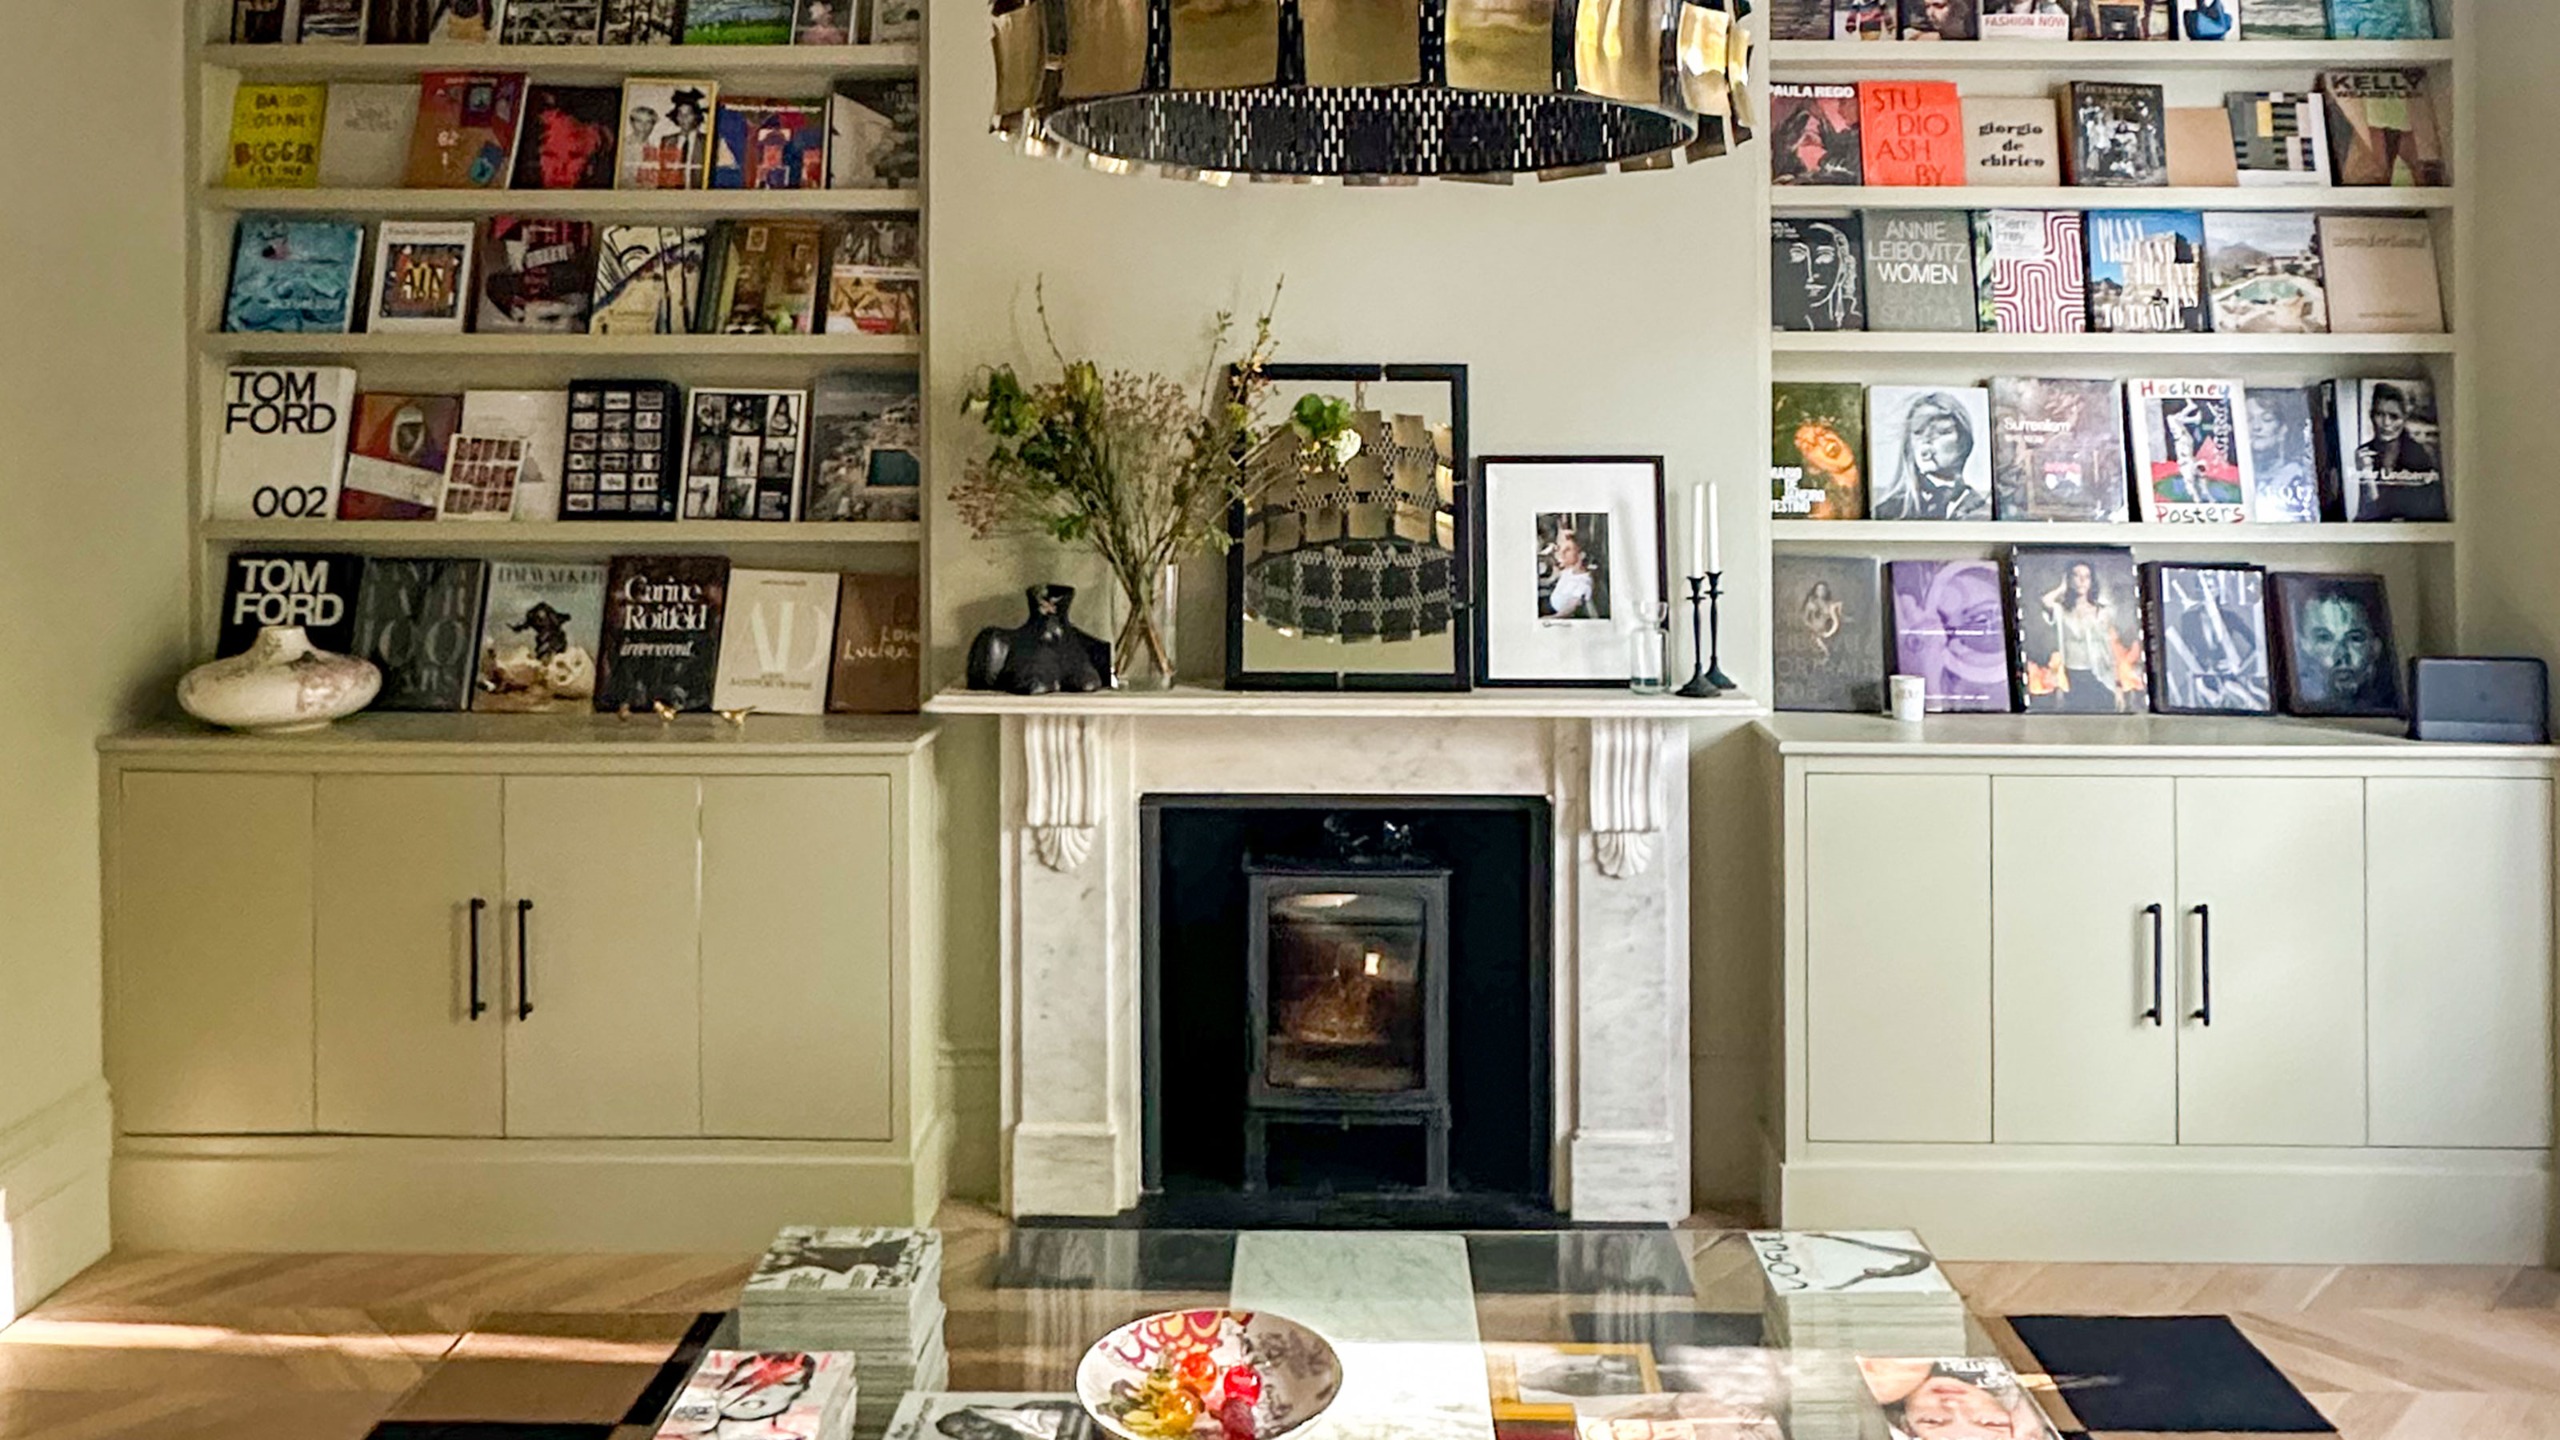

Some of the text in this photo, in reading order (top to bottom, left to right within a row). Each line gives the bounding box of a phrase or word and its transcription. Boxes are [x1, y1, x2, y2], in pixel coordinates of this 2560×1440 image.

[1984, 15, 2066, 28] FASHION NOW
[1814, 85, 1855, 99] REGO
[2331, 73, 2422, 91] KELLY
[1872, 88, 1922, 112] STU
[1897, 113, 1950, 137] DIO
[1979, 121, 2044, 137] giorgio
[1875, 138, 1932, 162] ASH
[2002, 138, 2024, 152] de
[1915, 163, 1946, 186] BY
[1885, 219, 1947, 241] ANNIE
[1867, 240, 1969, 262] LEIBOVITZ
[1877, 263, 1959, 285] WOMEN
[229, 371, 317, 402] TOM
[2140, 380, 2231, 402] Hockney
[226, 402, 338, 434] FORD
[253, 485, 328, 518] 002
[2154, 505, 2246, 524] Posters
[238, 558, 331, 594] TOM
[232, 592, 345, 627] FORD
